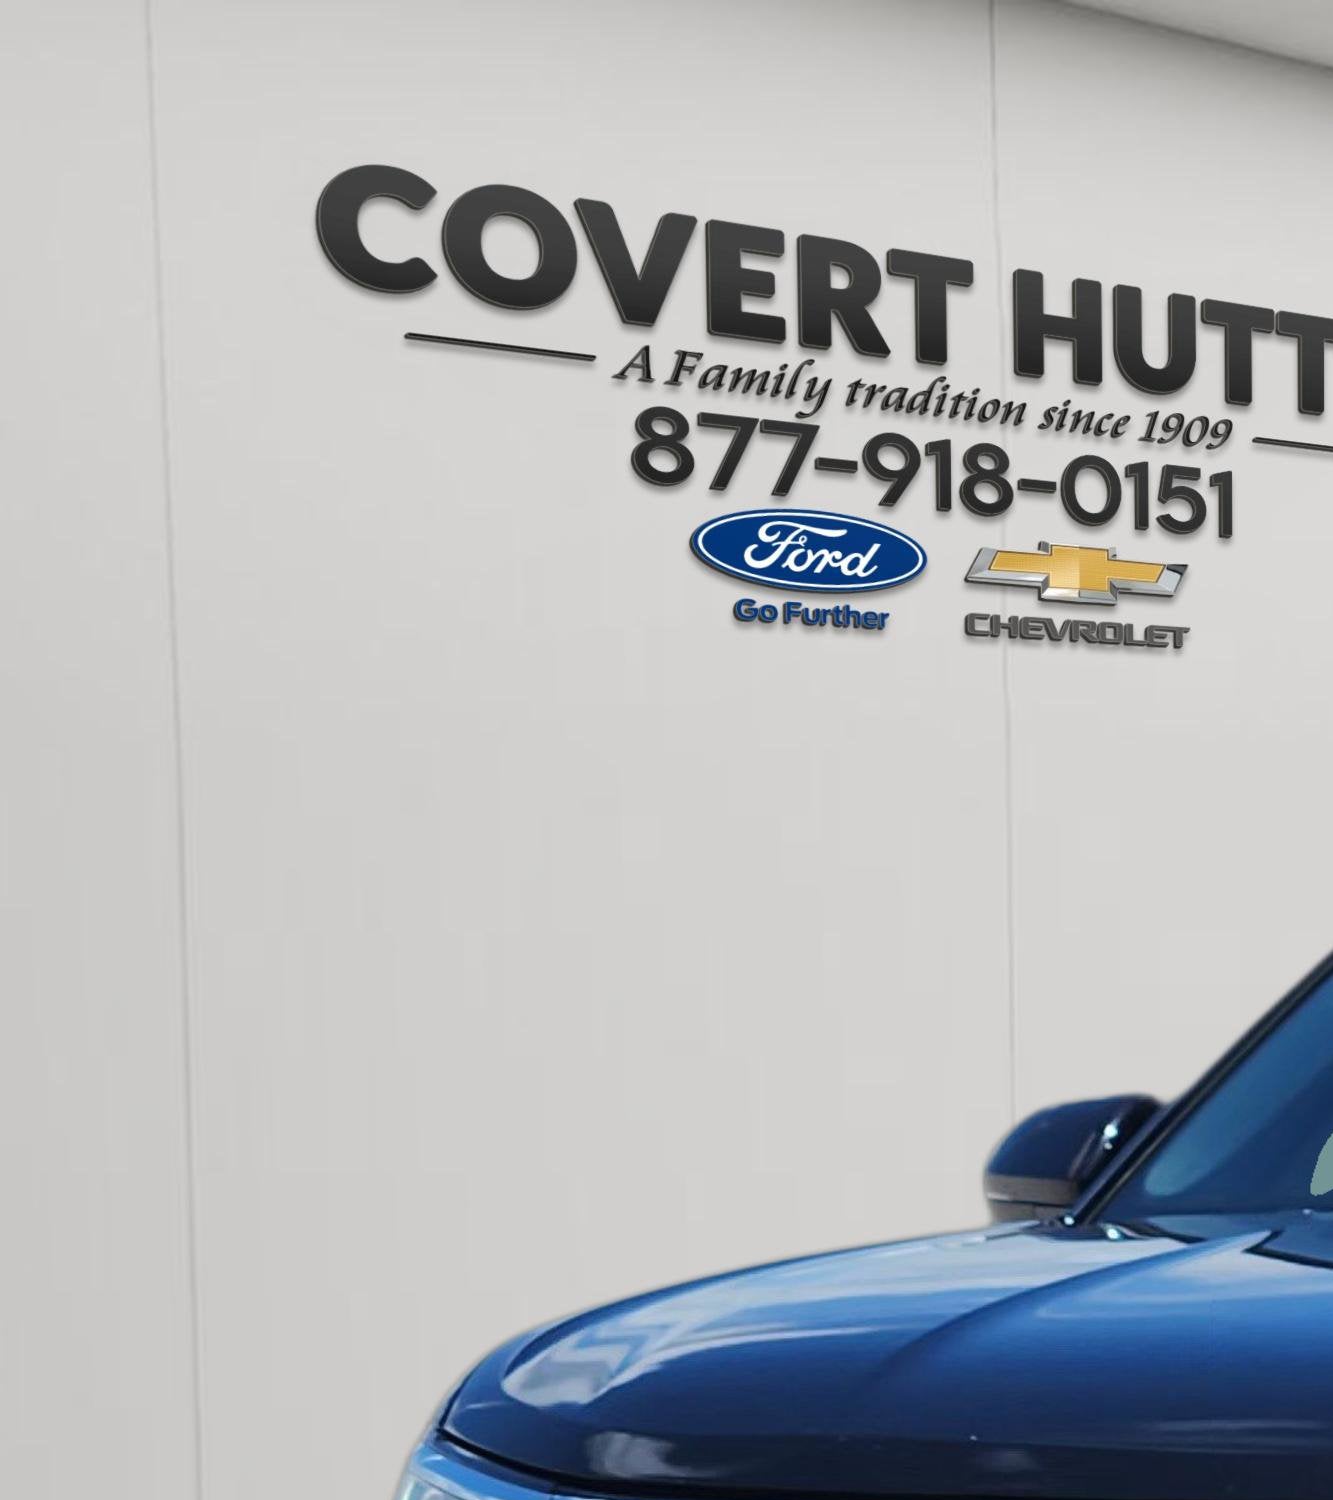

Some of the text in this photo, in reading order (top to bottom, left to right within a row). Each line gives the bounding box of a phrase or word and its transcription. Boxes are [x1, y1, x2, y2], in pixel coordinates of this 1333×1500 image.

[316, 164, 973, 366] COVERT
[611, 345, 1233, 450] A Family tradition since 1909
[631, 406, 1233, 538] 877-918-0151
[743, 520, 882, 578] Ford
[733, 598, 890, 631] Go Further
[964, 612, 1190, 650] CHEVROLET
